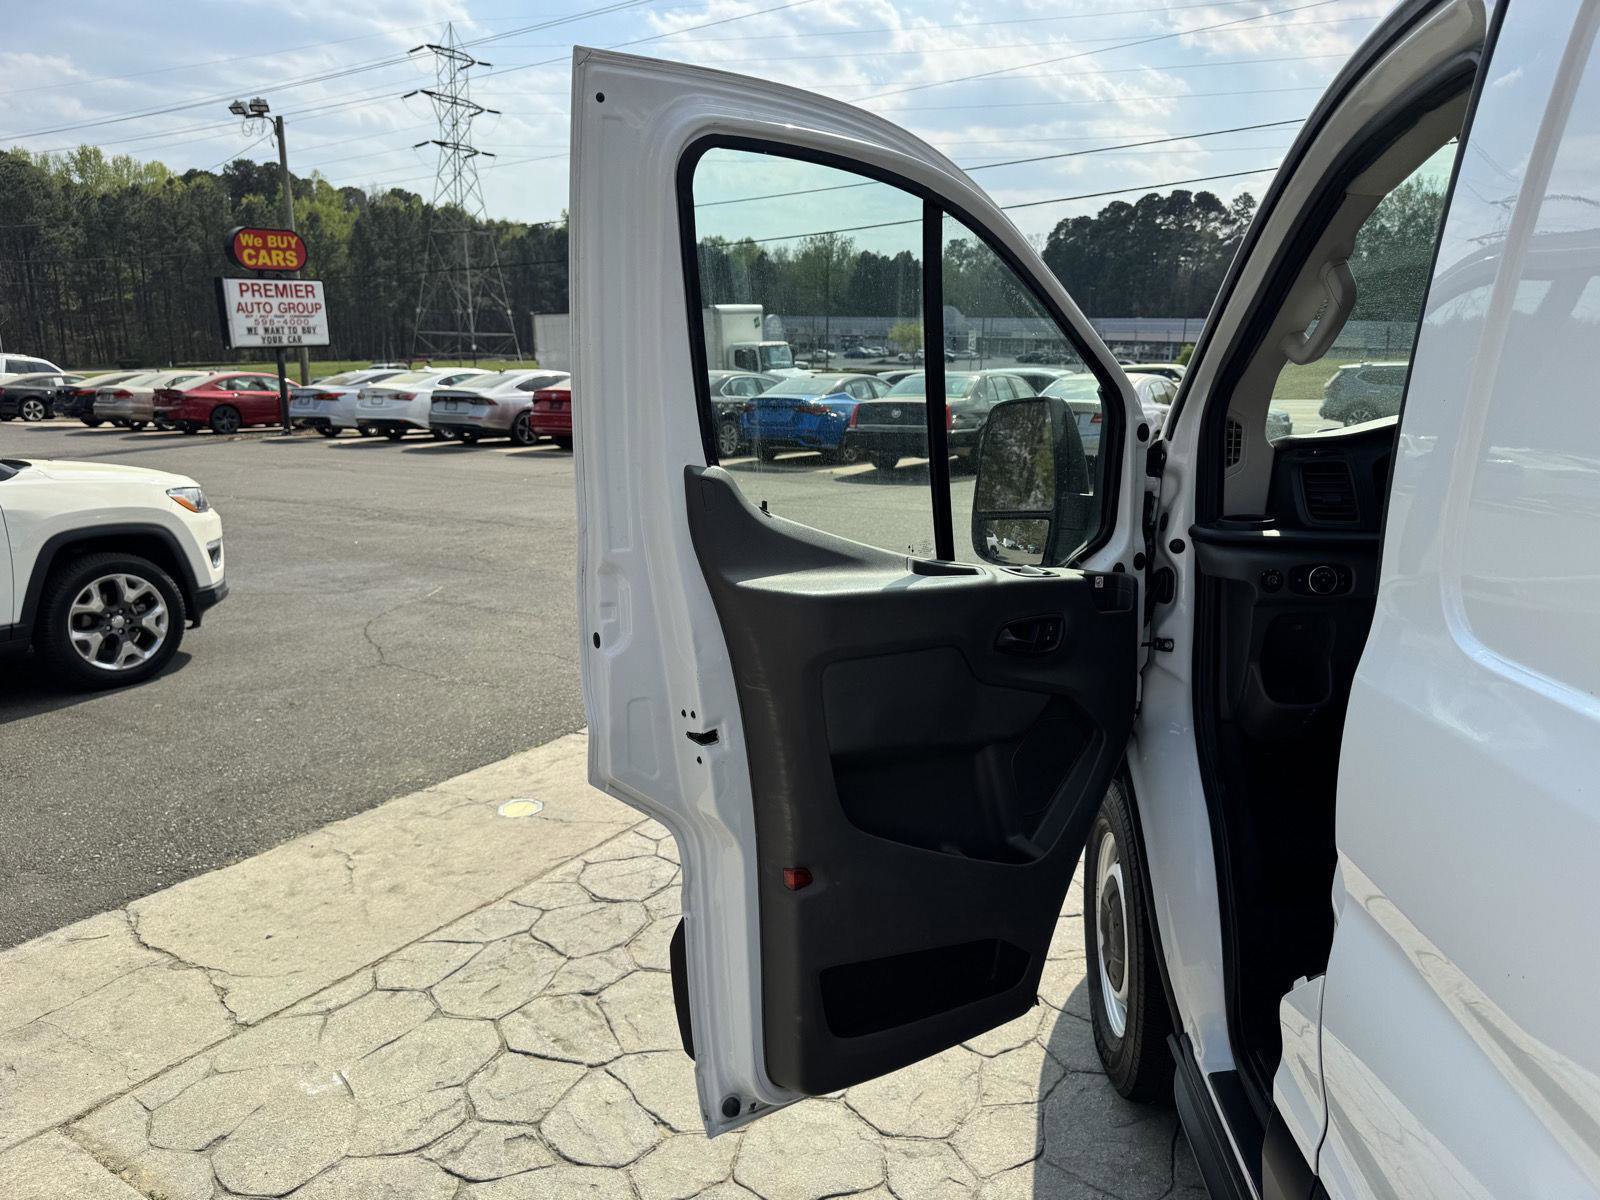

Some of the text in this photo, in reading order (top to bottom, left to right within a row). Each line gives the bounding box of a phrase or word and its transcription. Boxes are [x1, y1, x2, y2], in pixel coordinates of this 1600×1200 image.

[240, 233, 298, 249] We BUY
[242, 249, 298, 267] CARS
[238, 282, 316, 298] PREMIER
[236, 301, 322, 315] AUTO GROUP
[246, 326, 317, 335] WE WANT TO BUY
[261, 335, 303, 345] YOUR CAR
